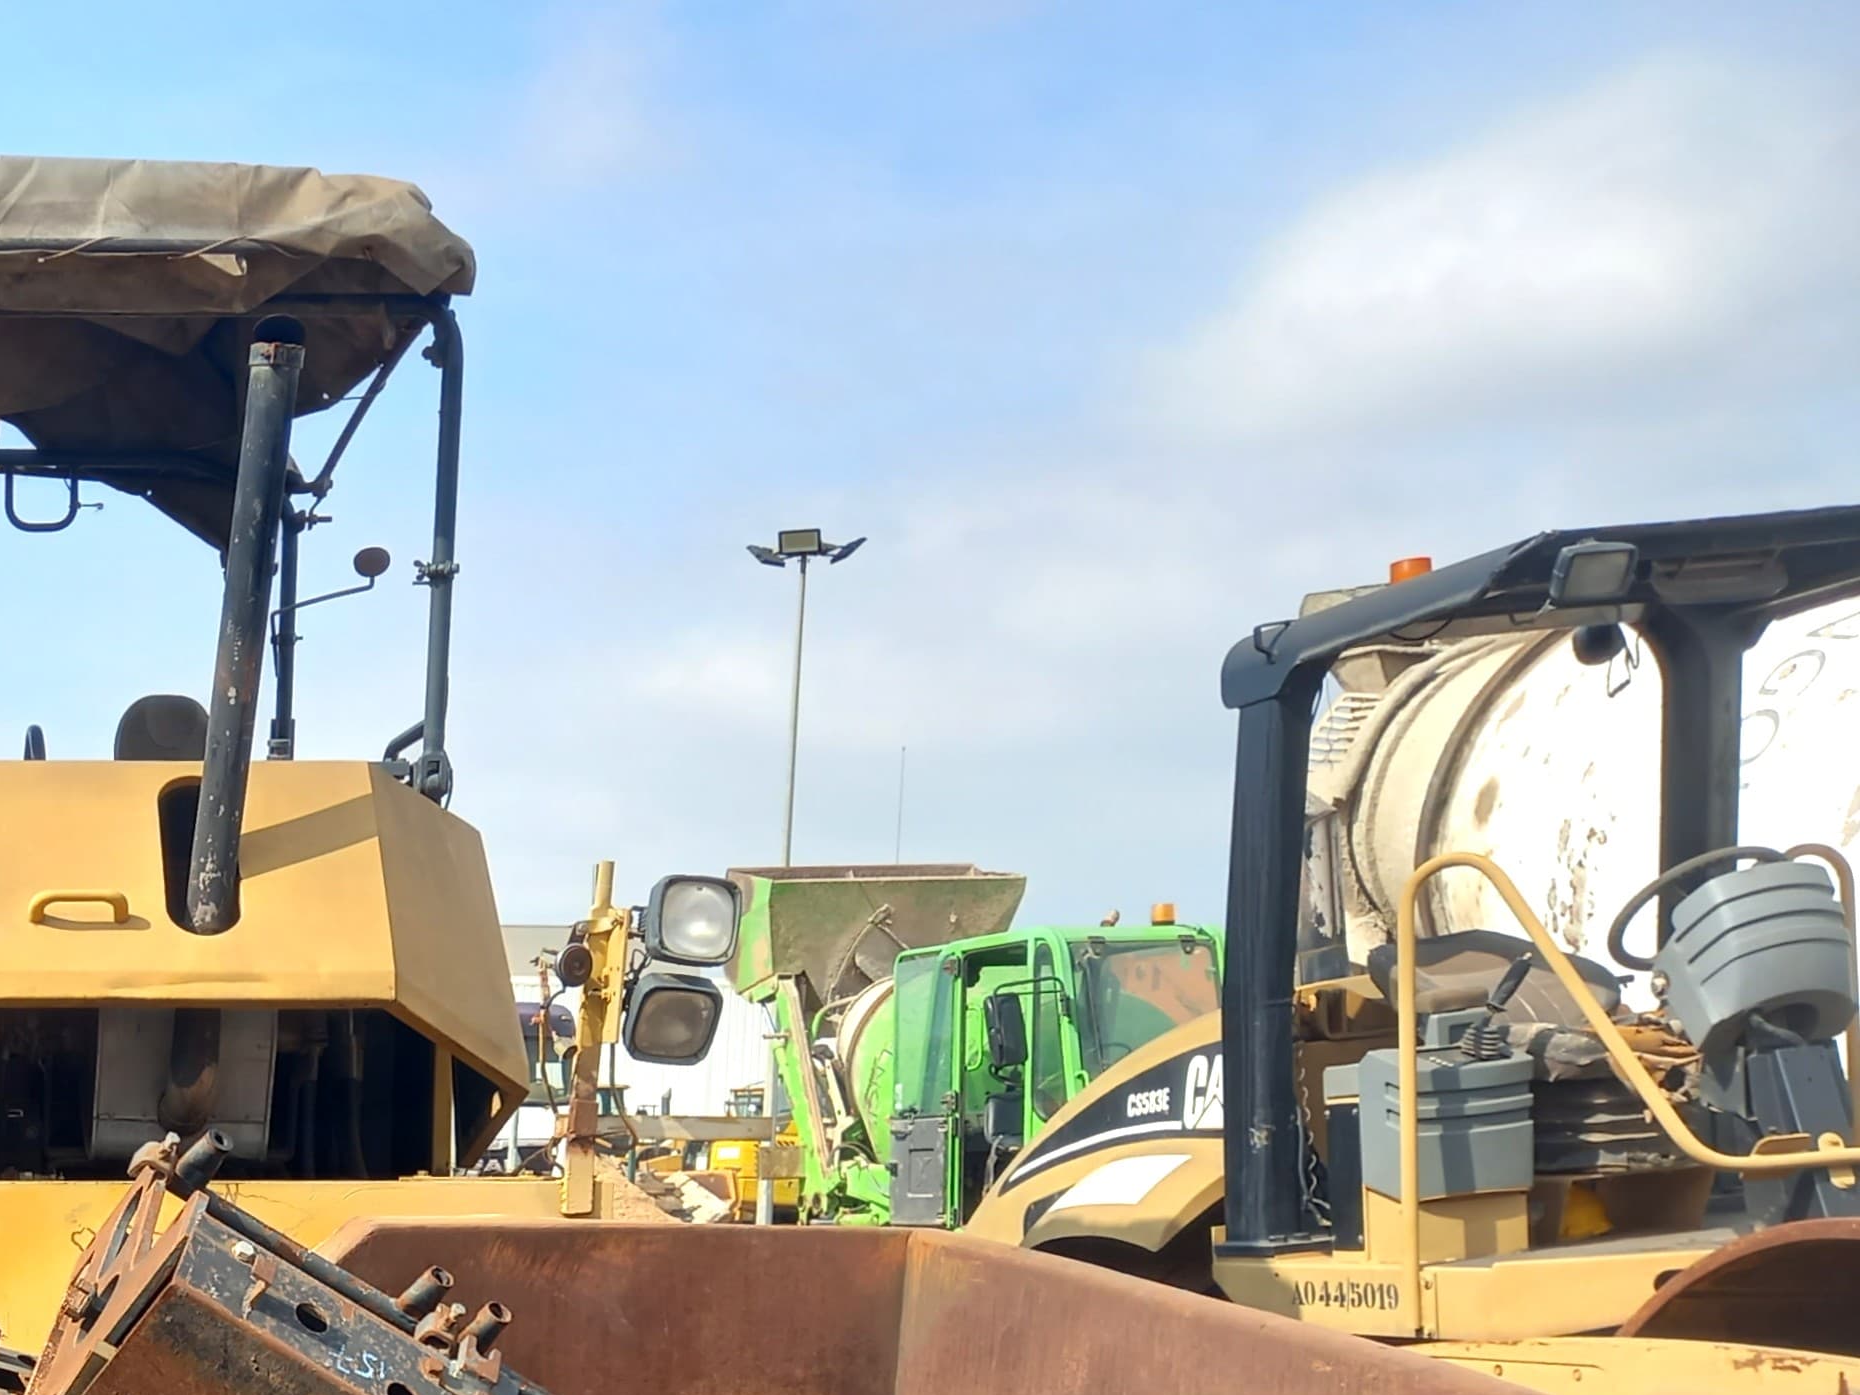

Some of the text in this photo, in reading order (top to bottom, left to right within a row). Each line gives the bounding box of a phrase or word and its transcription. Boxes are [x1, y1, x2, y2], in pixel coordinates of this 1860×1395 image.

[1126, 1087, 1171, 1118] CS583E
[1183, 1054, 1224, 1130] CA
[1291, 1278, 1400, 1312] A044/5019
